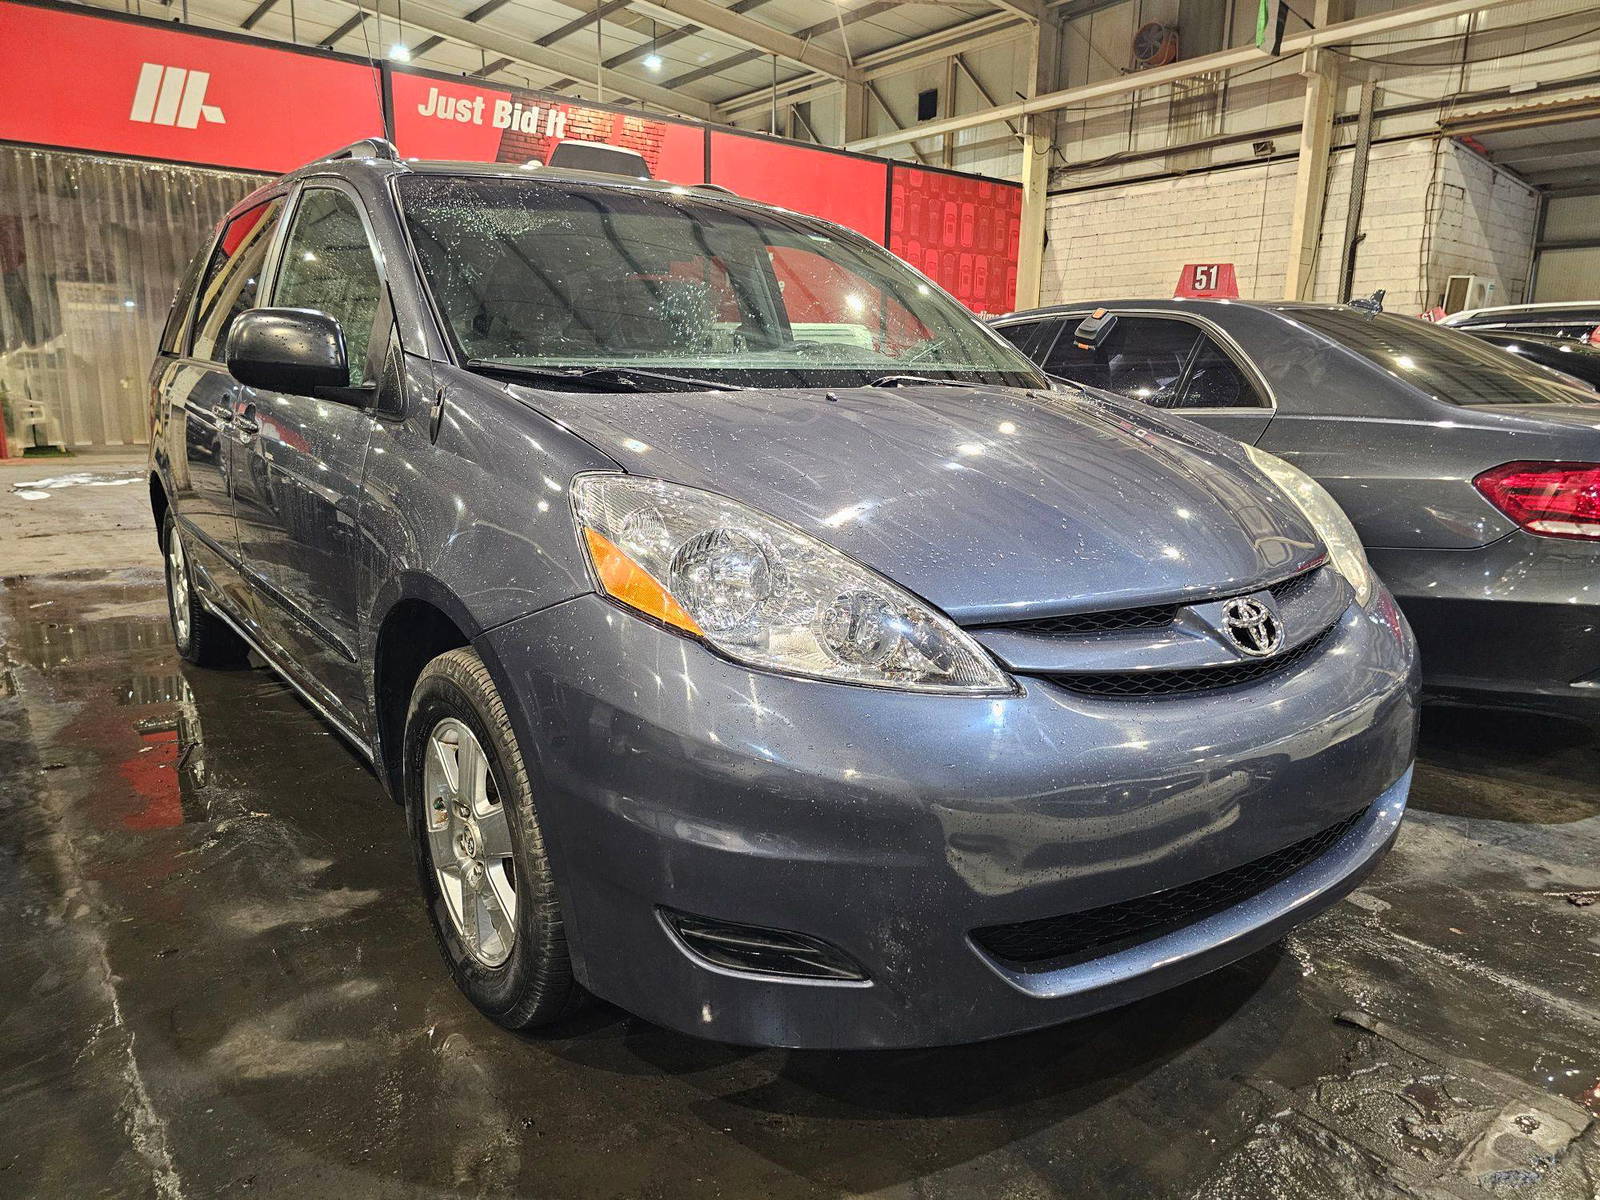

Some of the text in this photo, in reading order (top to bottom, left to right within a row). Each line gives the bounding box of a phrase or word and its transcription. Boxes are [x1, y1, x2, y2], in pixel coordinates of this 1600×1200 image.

[418, 87, 567, 139] Just Bid It
[1194, 265, 1218, 290] 51
